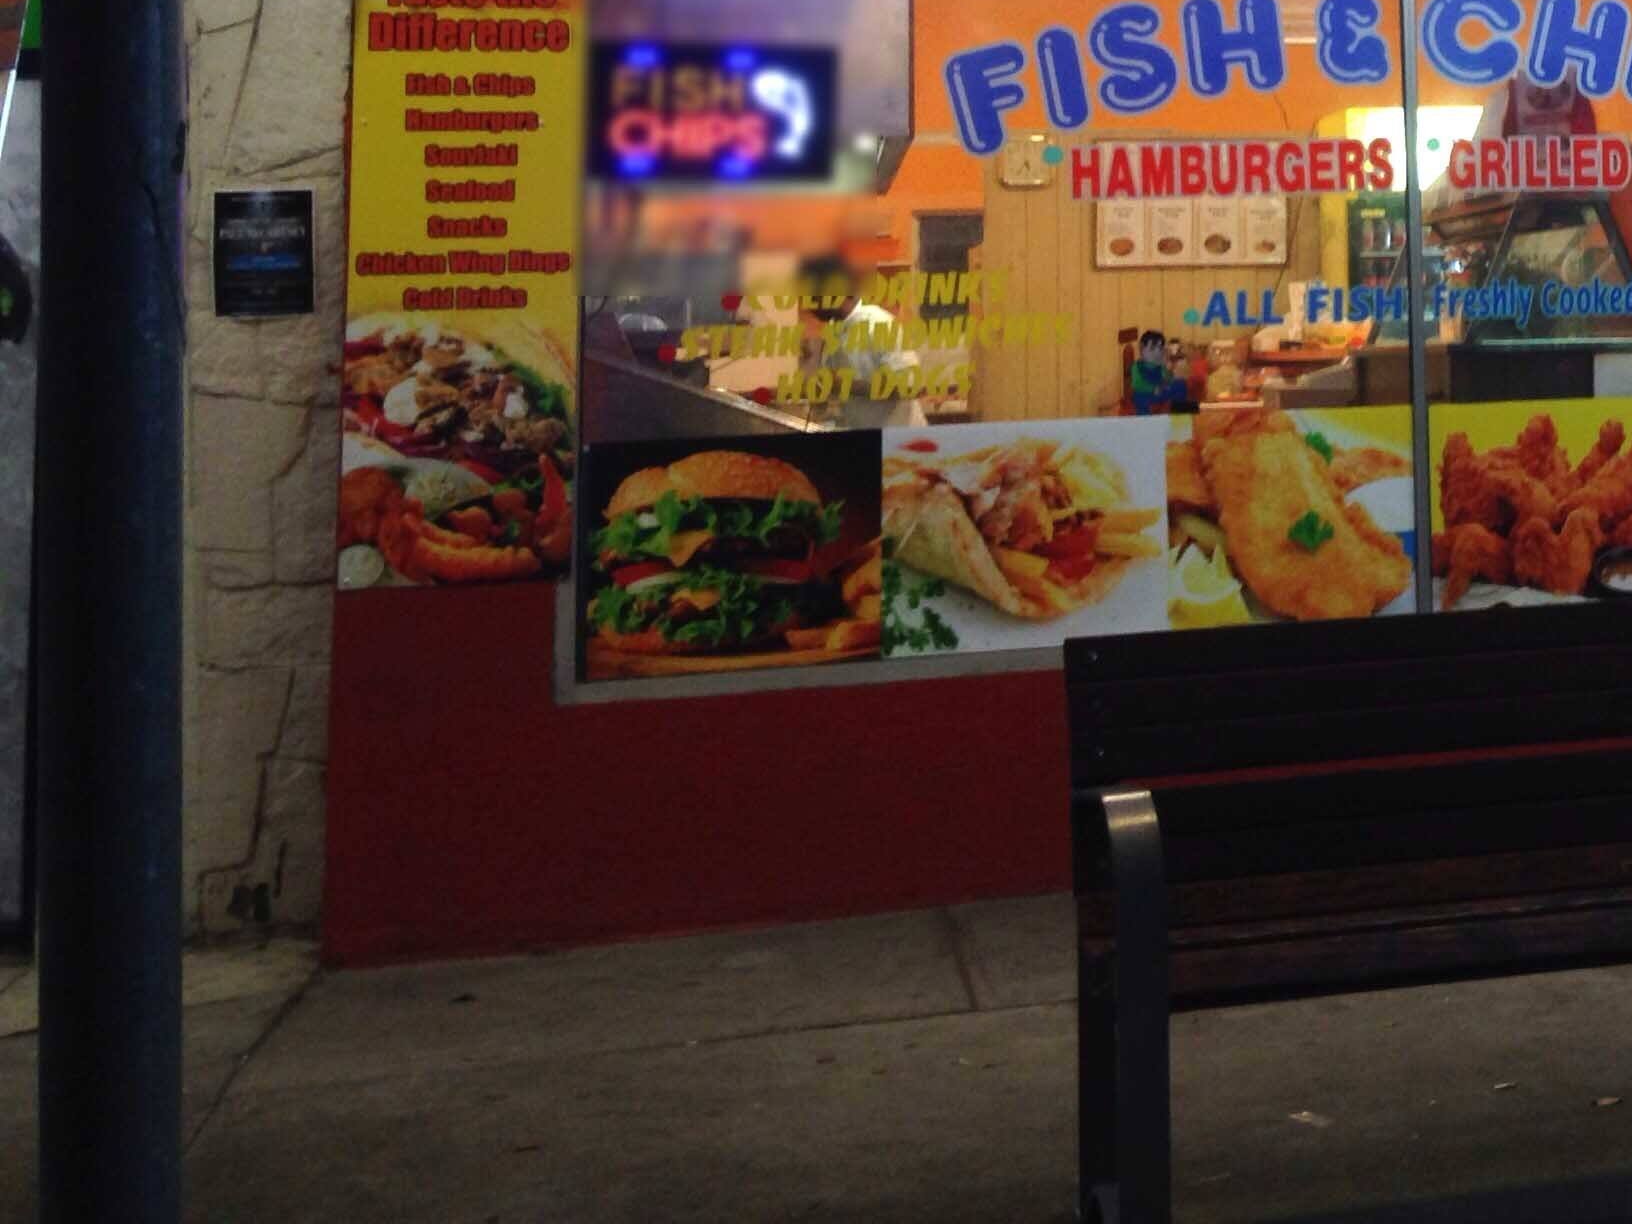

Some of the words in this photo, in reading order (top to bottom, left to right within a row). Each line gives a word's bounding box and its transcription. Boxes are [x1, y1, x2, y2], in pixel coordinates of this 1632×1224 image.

[368, 11, 570, 52] Difference
[405, 72, 451, 96] Fish
[453, 75, 471, 96] &
[473, 72, 536, 97] Chips
[405, 108, 539, 133] Hamburgers
[1069, 137, 1395, 200] HAMBURGERS
[1449, 134, 1632, 192] GRILLED
[427, 215, 507, 238] Snacks
[355, 251, 446, 275] Chicken
[402, 286, 453, 311] Cold
[454, 285, 528, 310] Drinks
[1202, 290, 1284, 326] ALL
[1306, 285, 1402, 324] FISH
[1432, 279, 1532, 329] Freshly
[679, 323, 803, 361] STEAK
[821, 311, 1076, 358] SANDWICHES
[775, 368, 857, 405] HOT
[869, 361, 976, 401] DOGS
